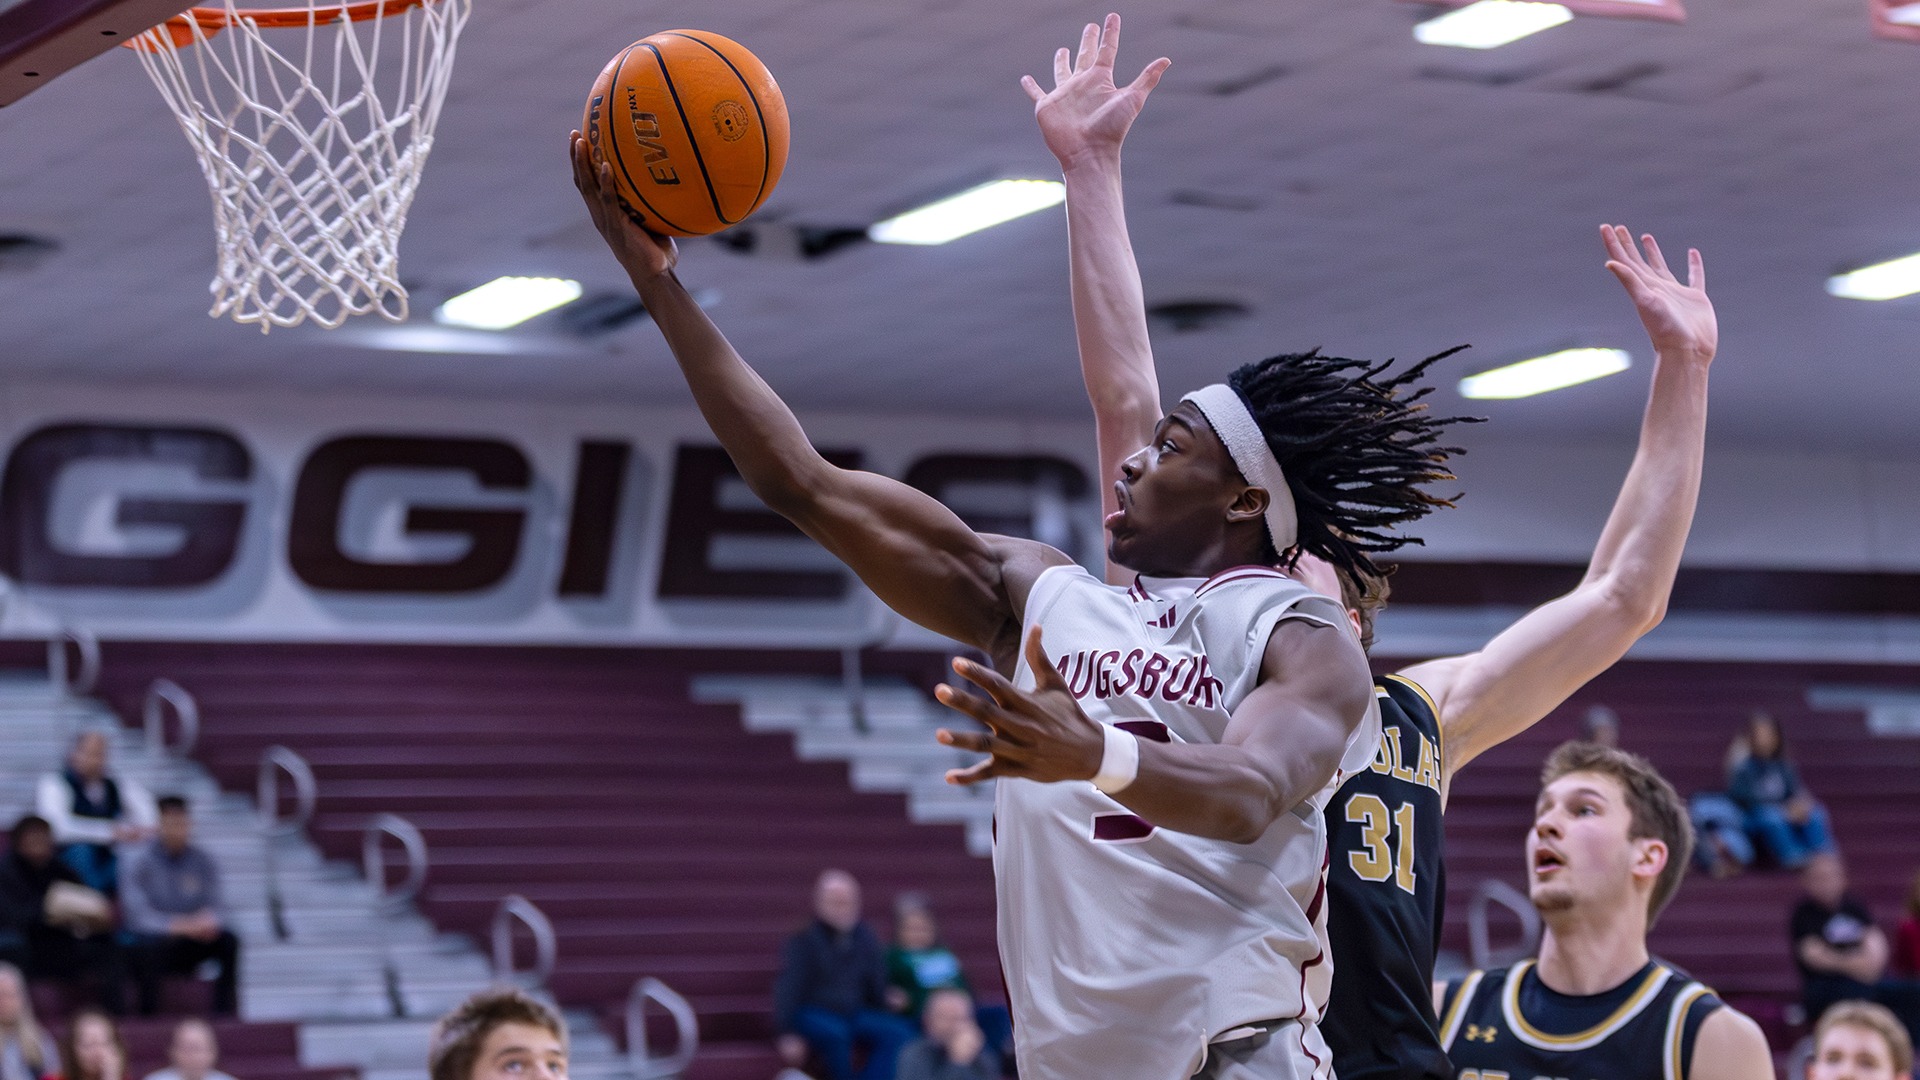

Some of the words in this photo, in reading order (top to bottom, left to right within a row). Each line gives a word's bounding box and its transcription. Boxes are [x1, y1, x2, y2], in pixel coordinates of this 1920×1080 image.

[627, 86, 638, 111] NXT
[631, 111, 681, 185] EVO
[1345, 793, 1416, 895] 31
